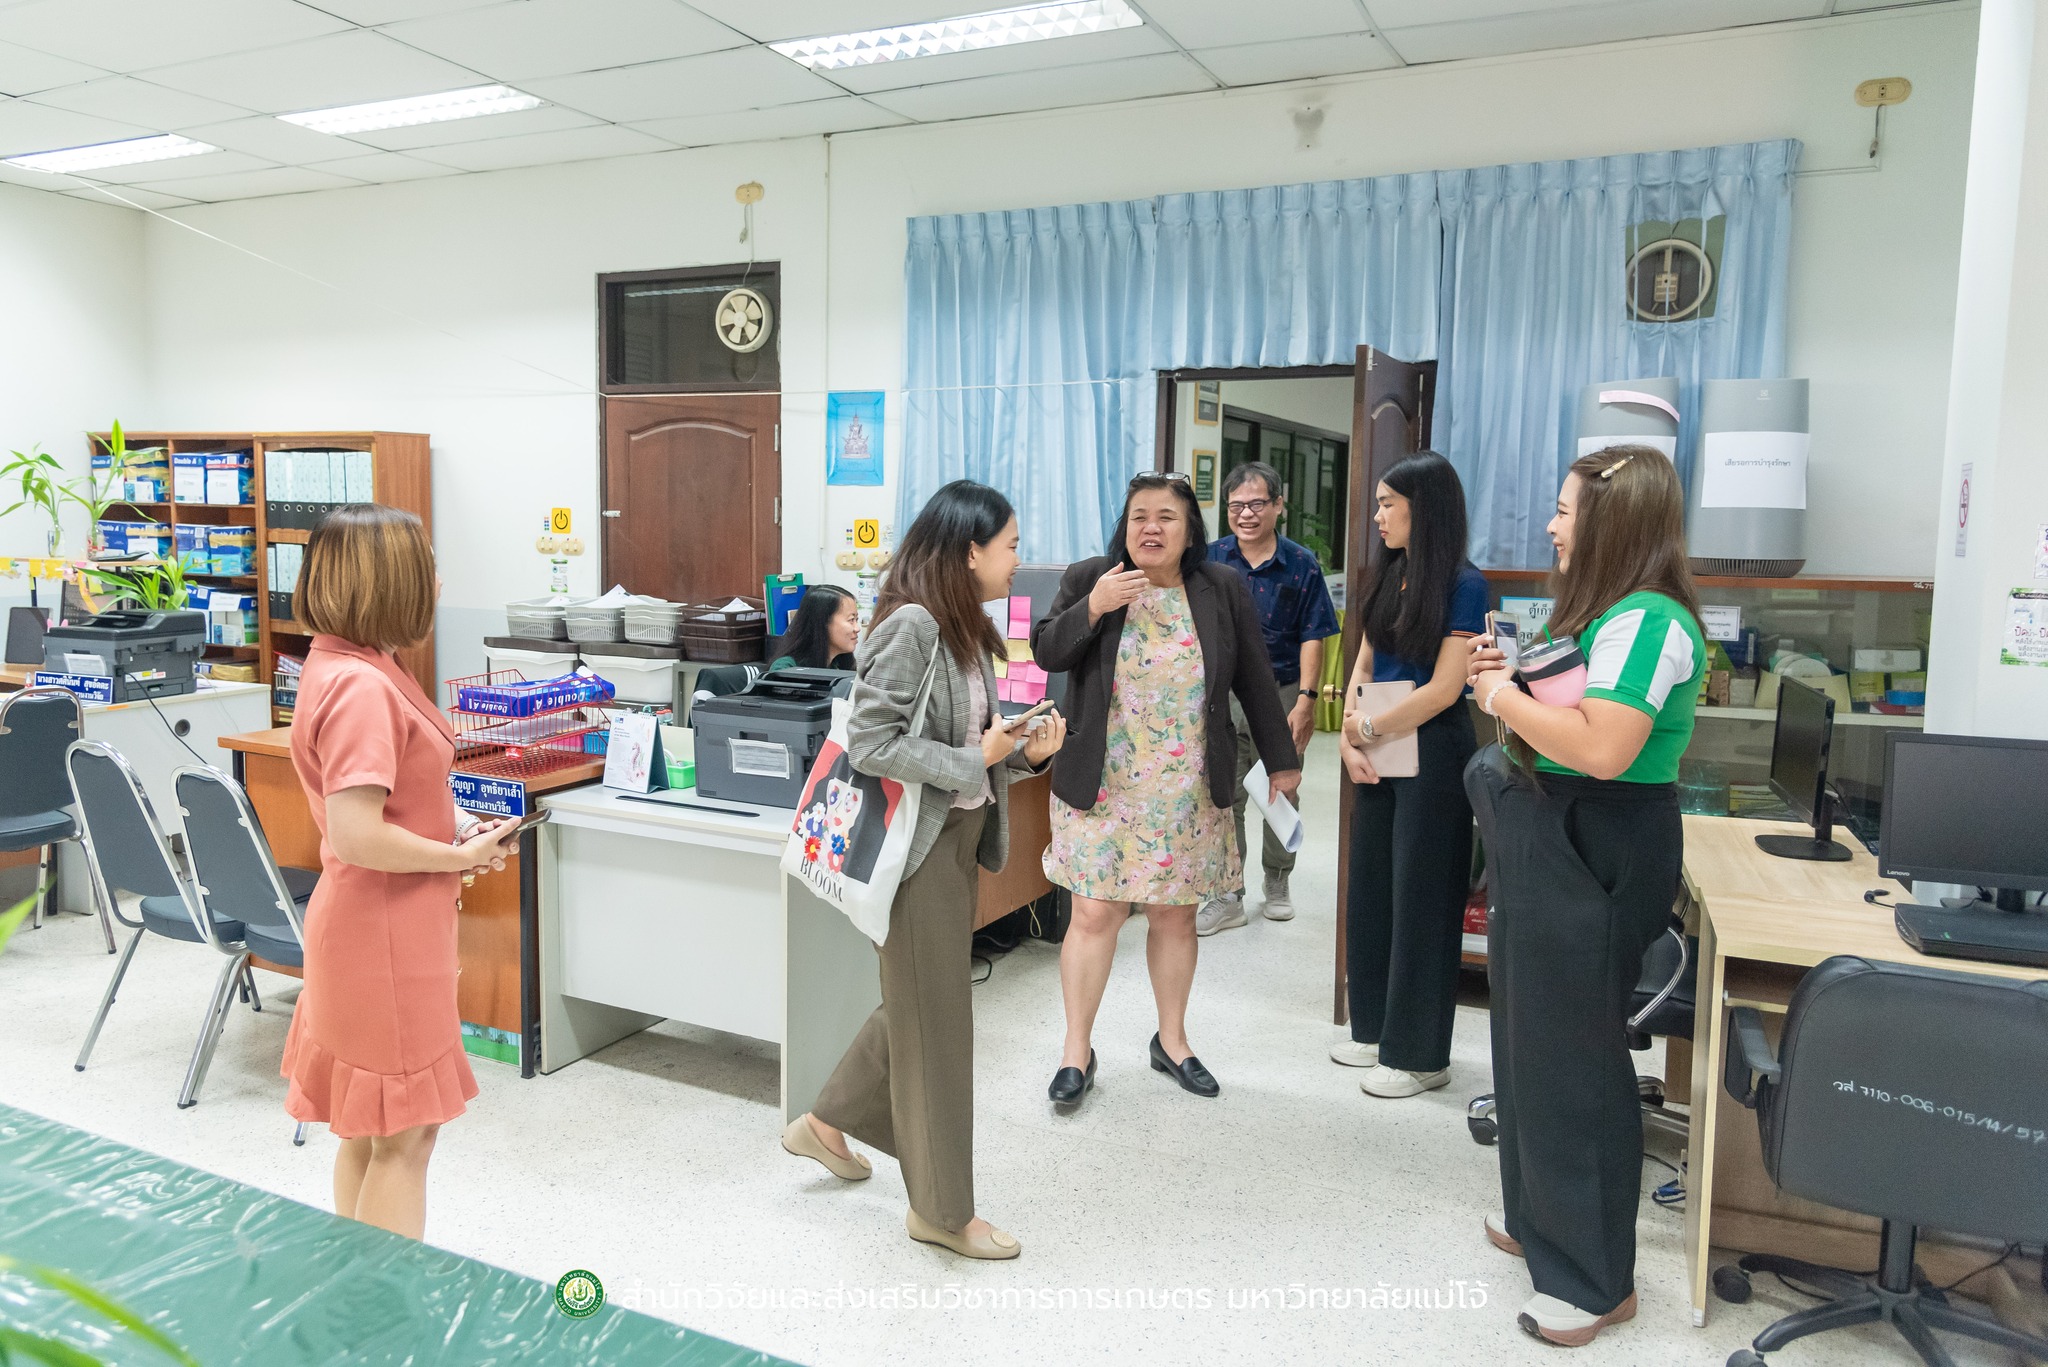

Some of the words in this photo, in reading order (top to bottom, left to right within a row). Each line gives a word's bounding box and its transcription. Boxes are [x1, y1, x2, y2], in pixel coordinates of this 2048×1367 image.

[547, 691, 585, 706] Double
[800, 856, 843, 902] BLOOM
[1886, 869, 1910, 877] Lenovo
